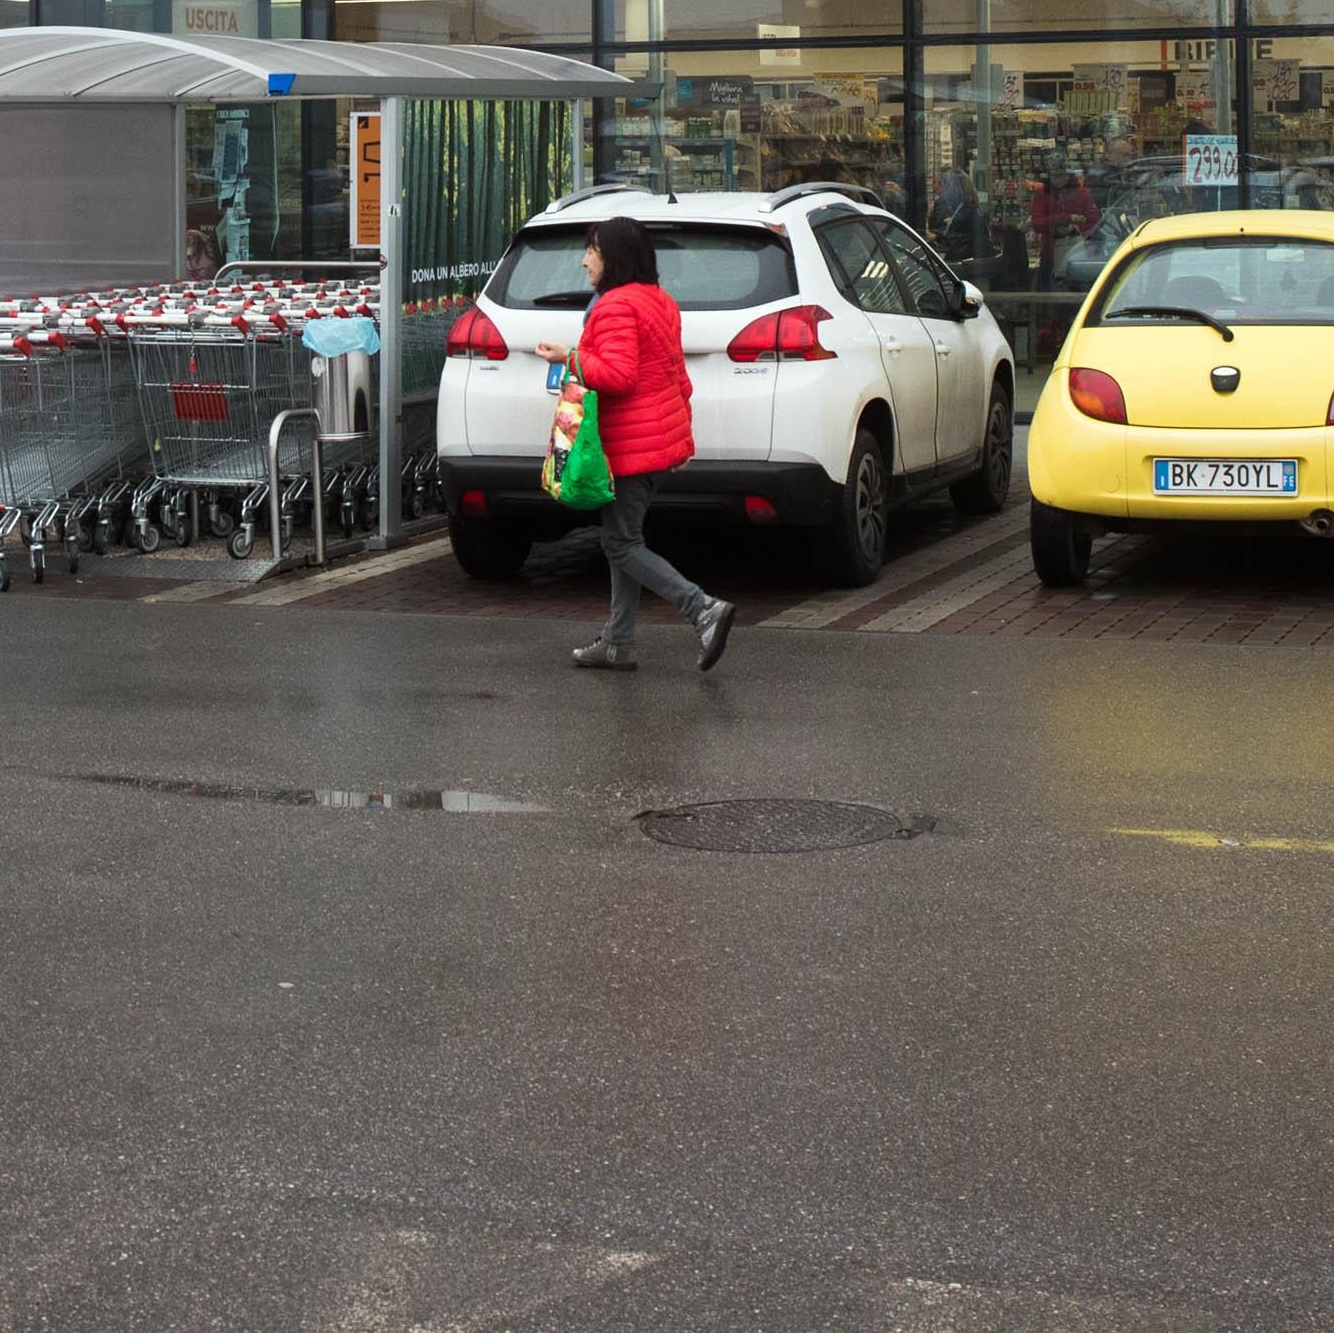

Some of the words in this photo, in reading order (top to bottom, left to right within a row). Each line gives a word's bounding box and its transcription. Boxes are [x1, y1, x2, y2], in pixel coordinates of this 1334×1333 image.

[184, 8, 239, 33] USCITA
[412, 268, 436, 283] DONA
[436, 266, 448, 280] UN
[449, 263, 479, 278] ALBERO
[1172, 464, 1198, 487] BK
